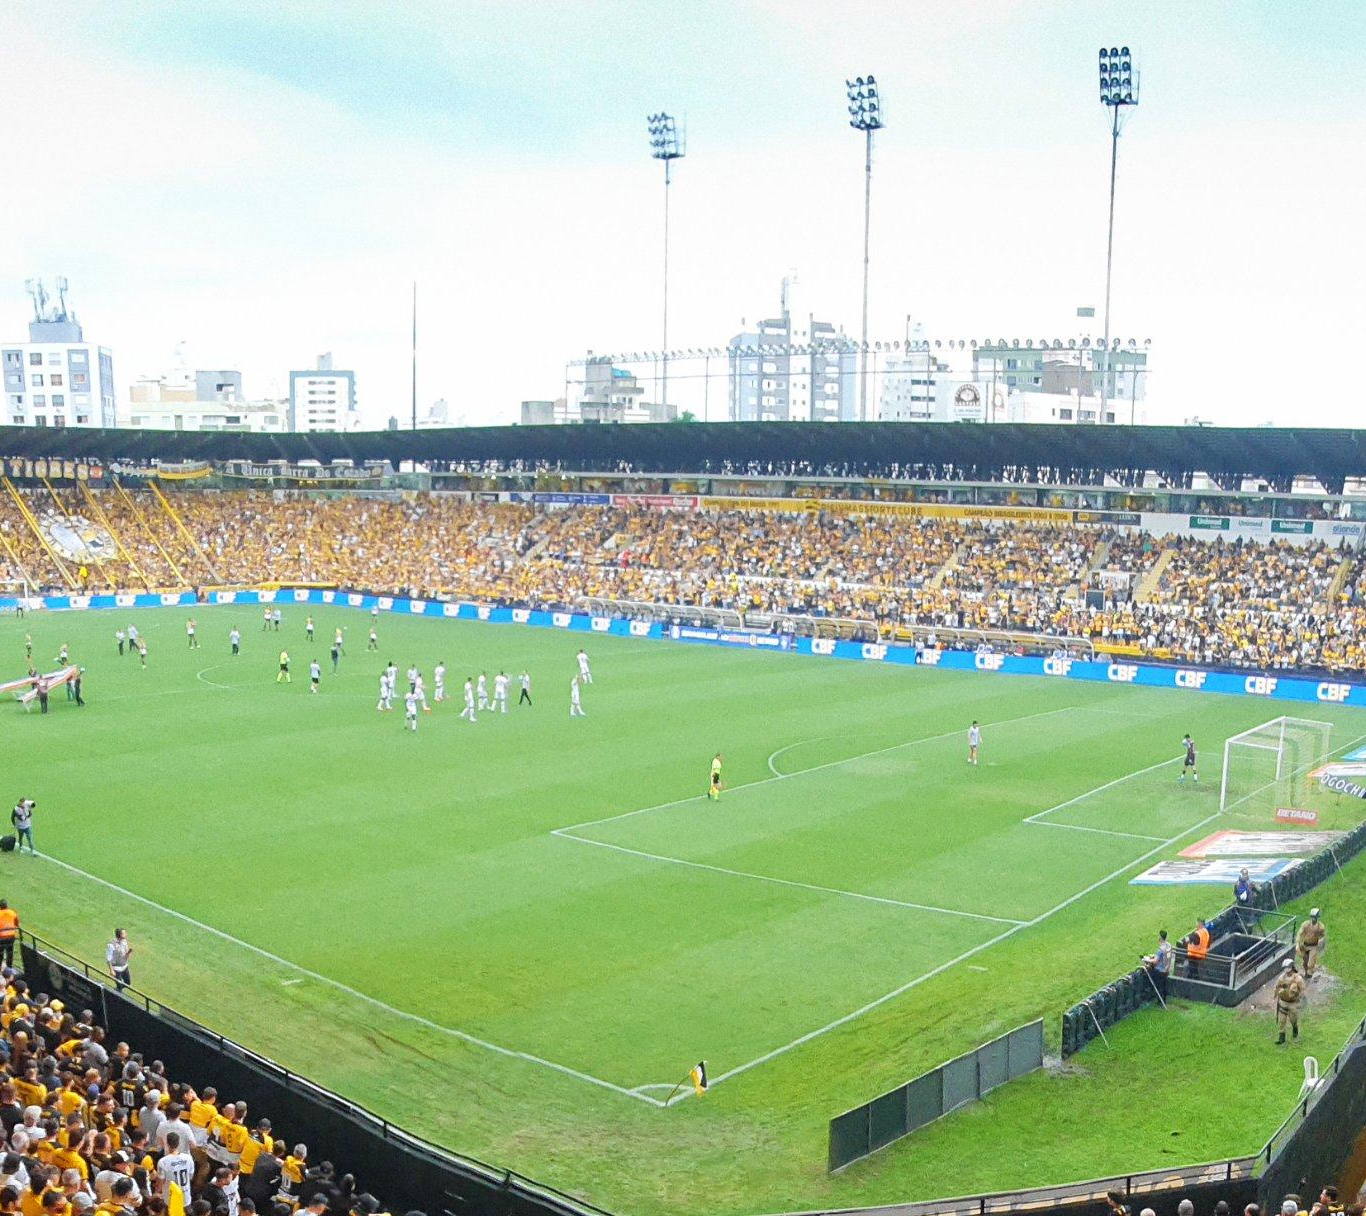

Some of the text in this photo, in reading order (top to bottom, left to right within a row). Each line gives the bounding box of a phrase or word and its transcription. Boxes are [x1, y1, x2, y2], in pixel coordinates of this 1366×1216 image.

[975, 650, 1005, 670] CBF
[1043, 657, 1073, 676] CBF
[1107, 663, 1139, 682] CBF
[1174, 670, 1208, 689] CBF
[1244, 676, 1278, 695] CBF
[1317, 682, 1352, 702] CBF
